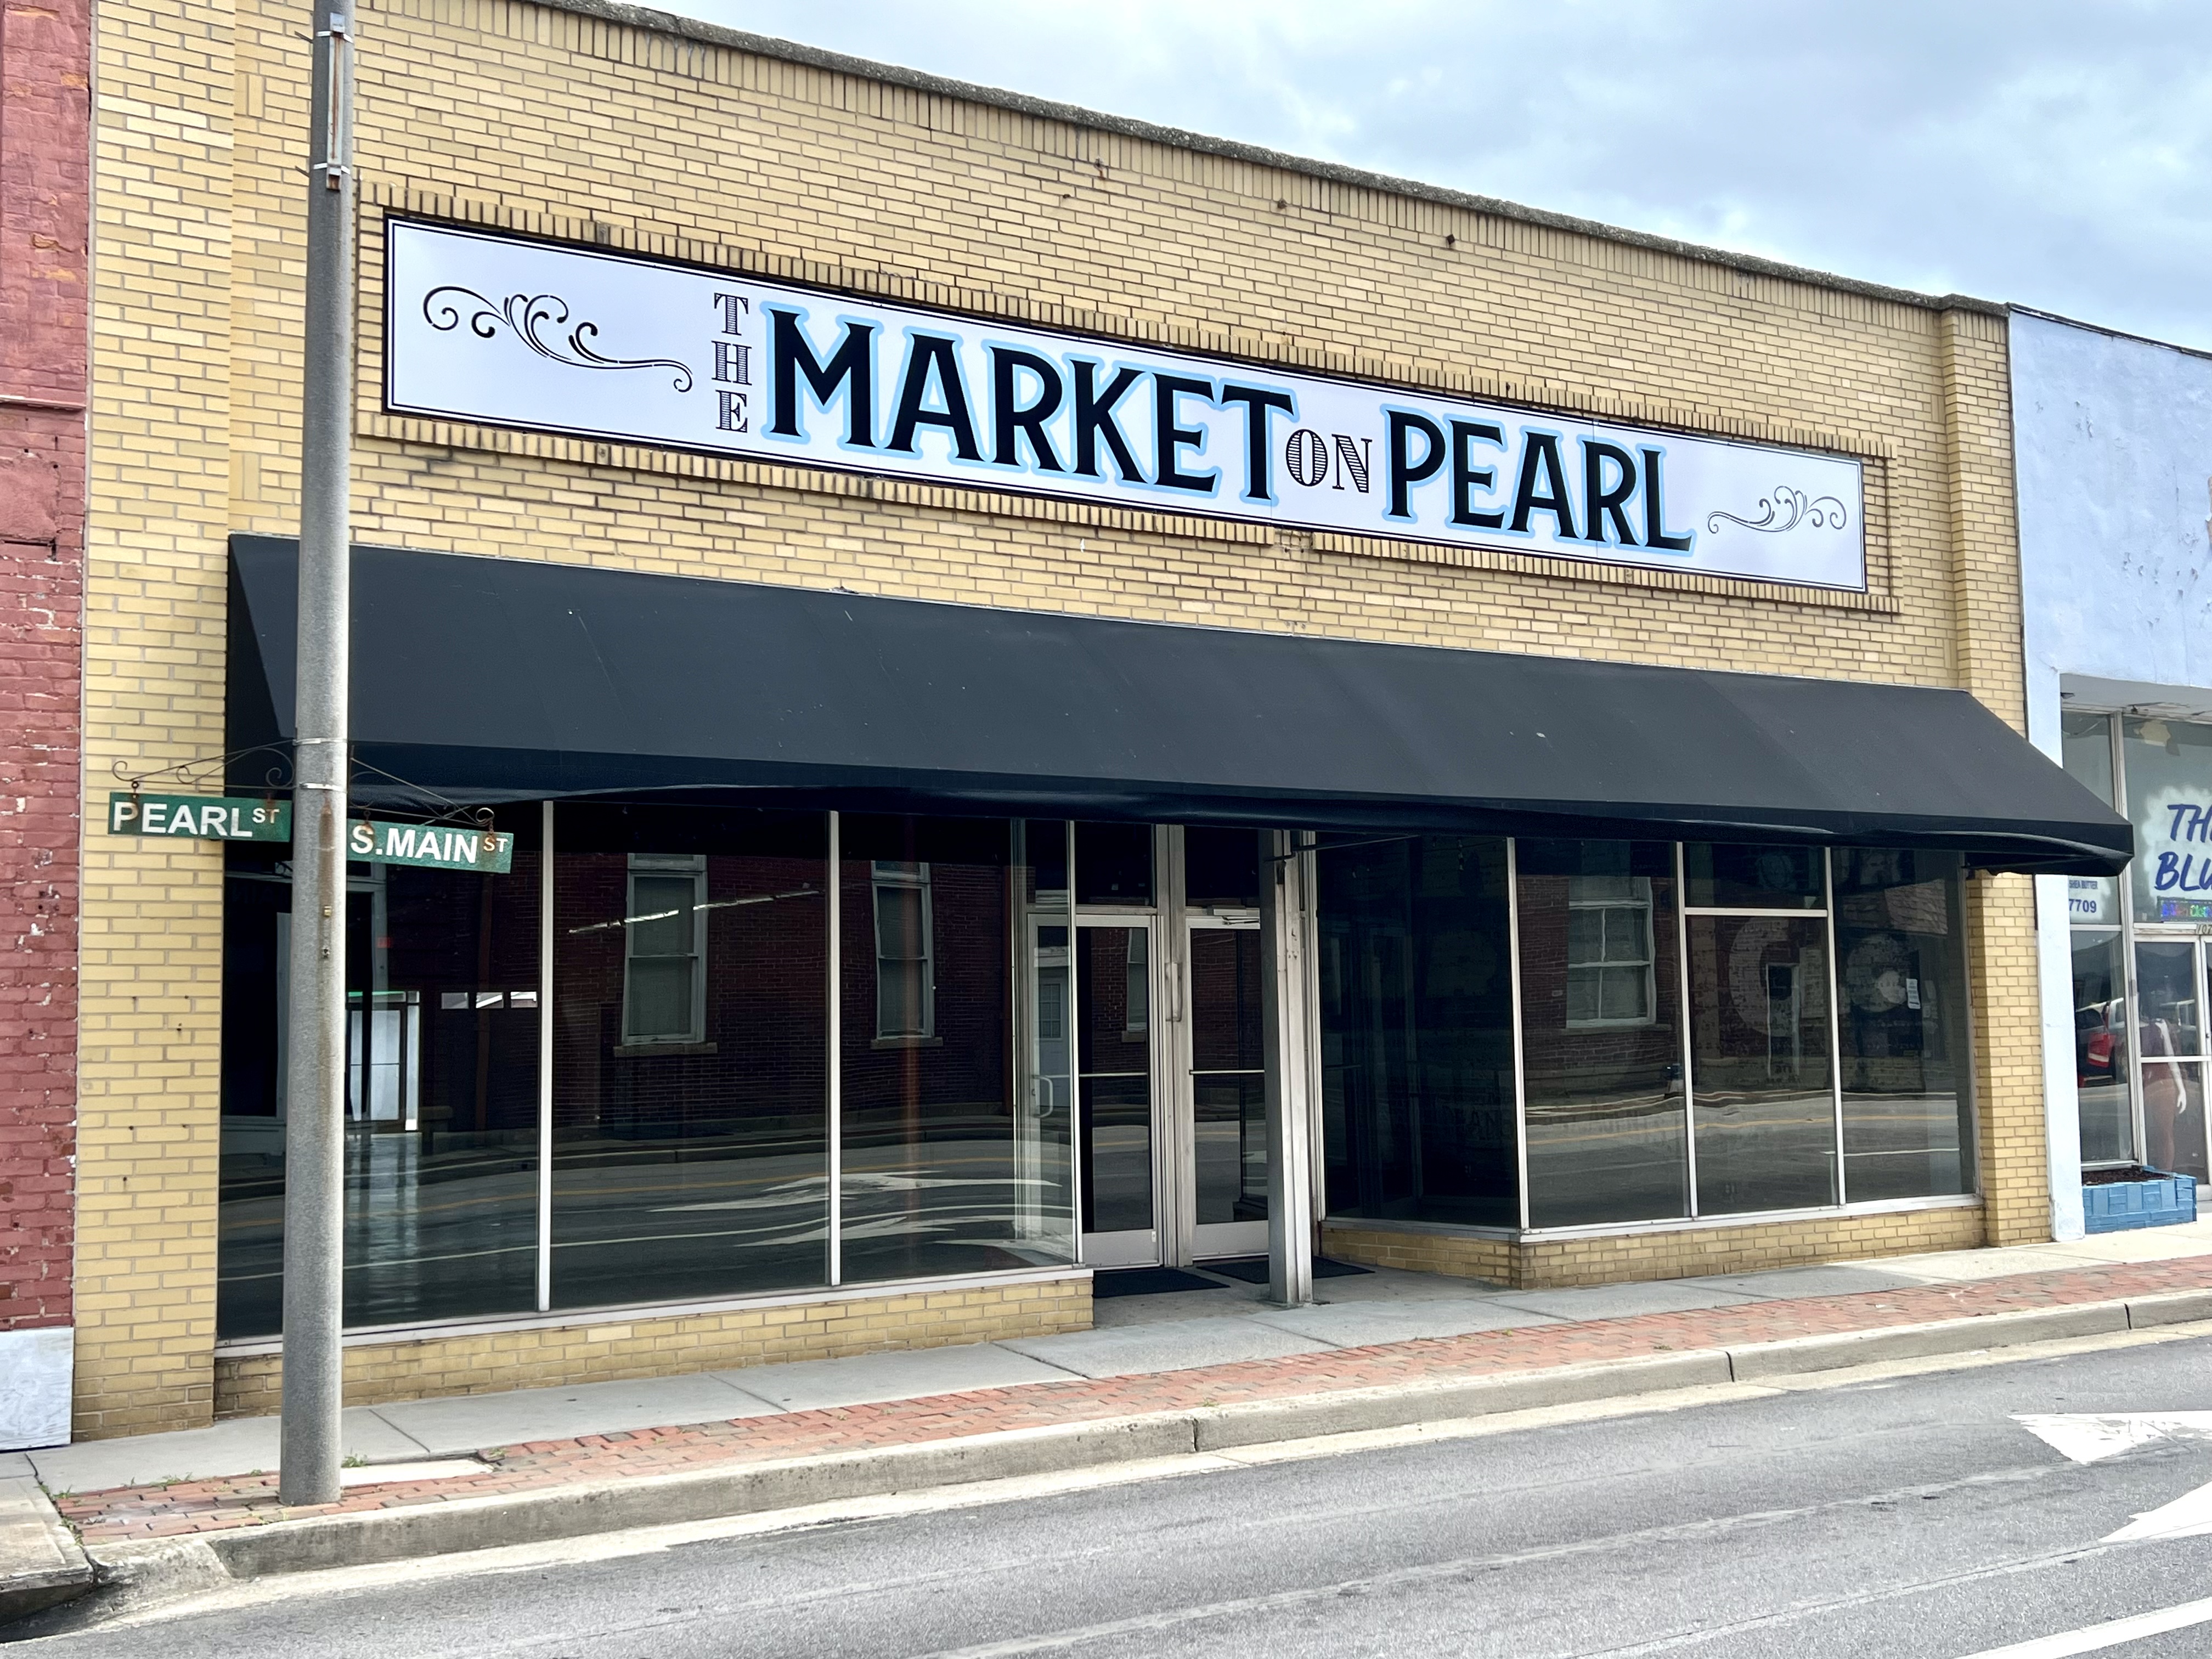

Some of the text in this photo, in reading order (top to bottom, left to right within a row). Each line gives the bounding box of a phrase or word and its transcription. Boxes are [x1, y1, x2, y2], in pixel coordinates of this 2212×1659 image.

[711, 292, 1692, 552] THE MARKET ON PEARL
[113, 800, 280, 837] PEARL ST
[2167, 803, 2212, 843] TH
[350, 825, 509, 864] S.MAIN ST
[2068, 898, 2097, 913] 7709
